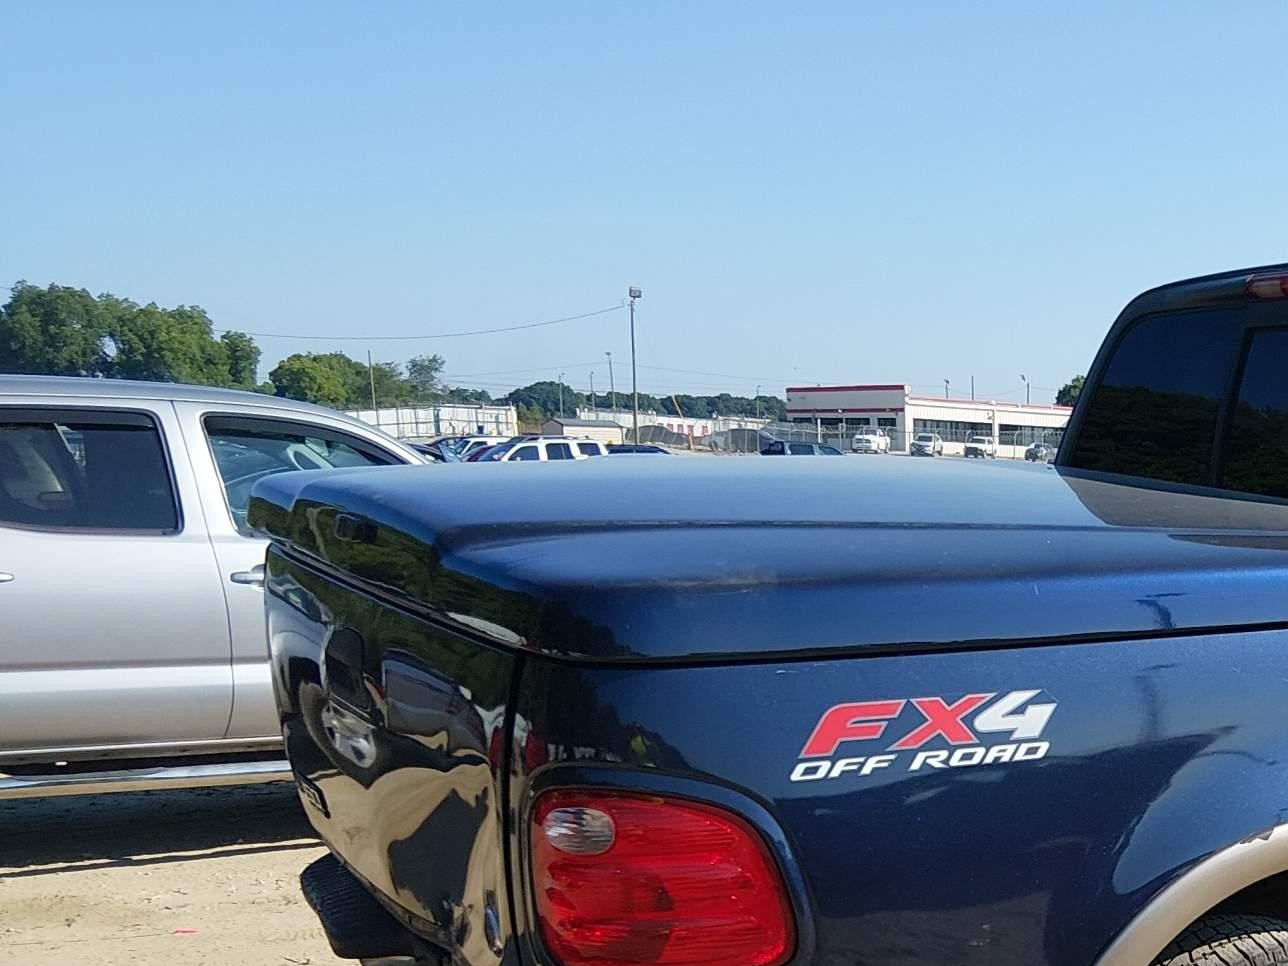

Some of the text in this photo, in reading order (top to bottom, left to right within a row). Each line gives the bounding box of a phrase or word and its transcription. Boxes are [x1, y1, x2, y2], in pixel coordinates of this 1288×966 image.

[798, 688, 1058, 759] FX4
[790, 741, 1050, 782] OFF ROAD
